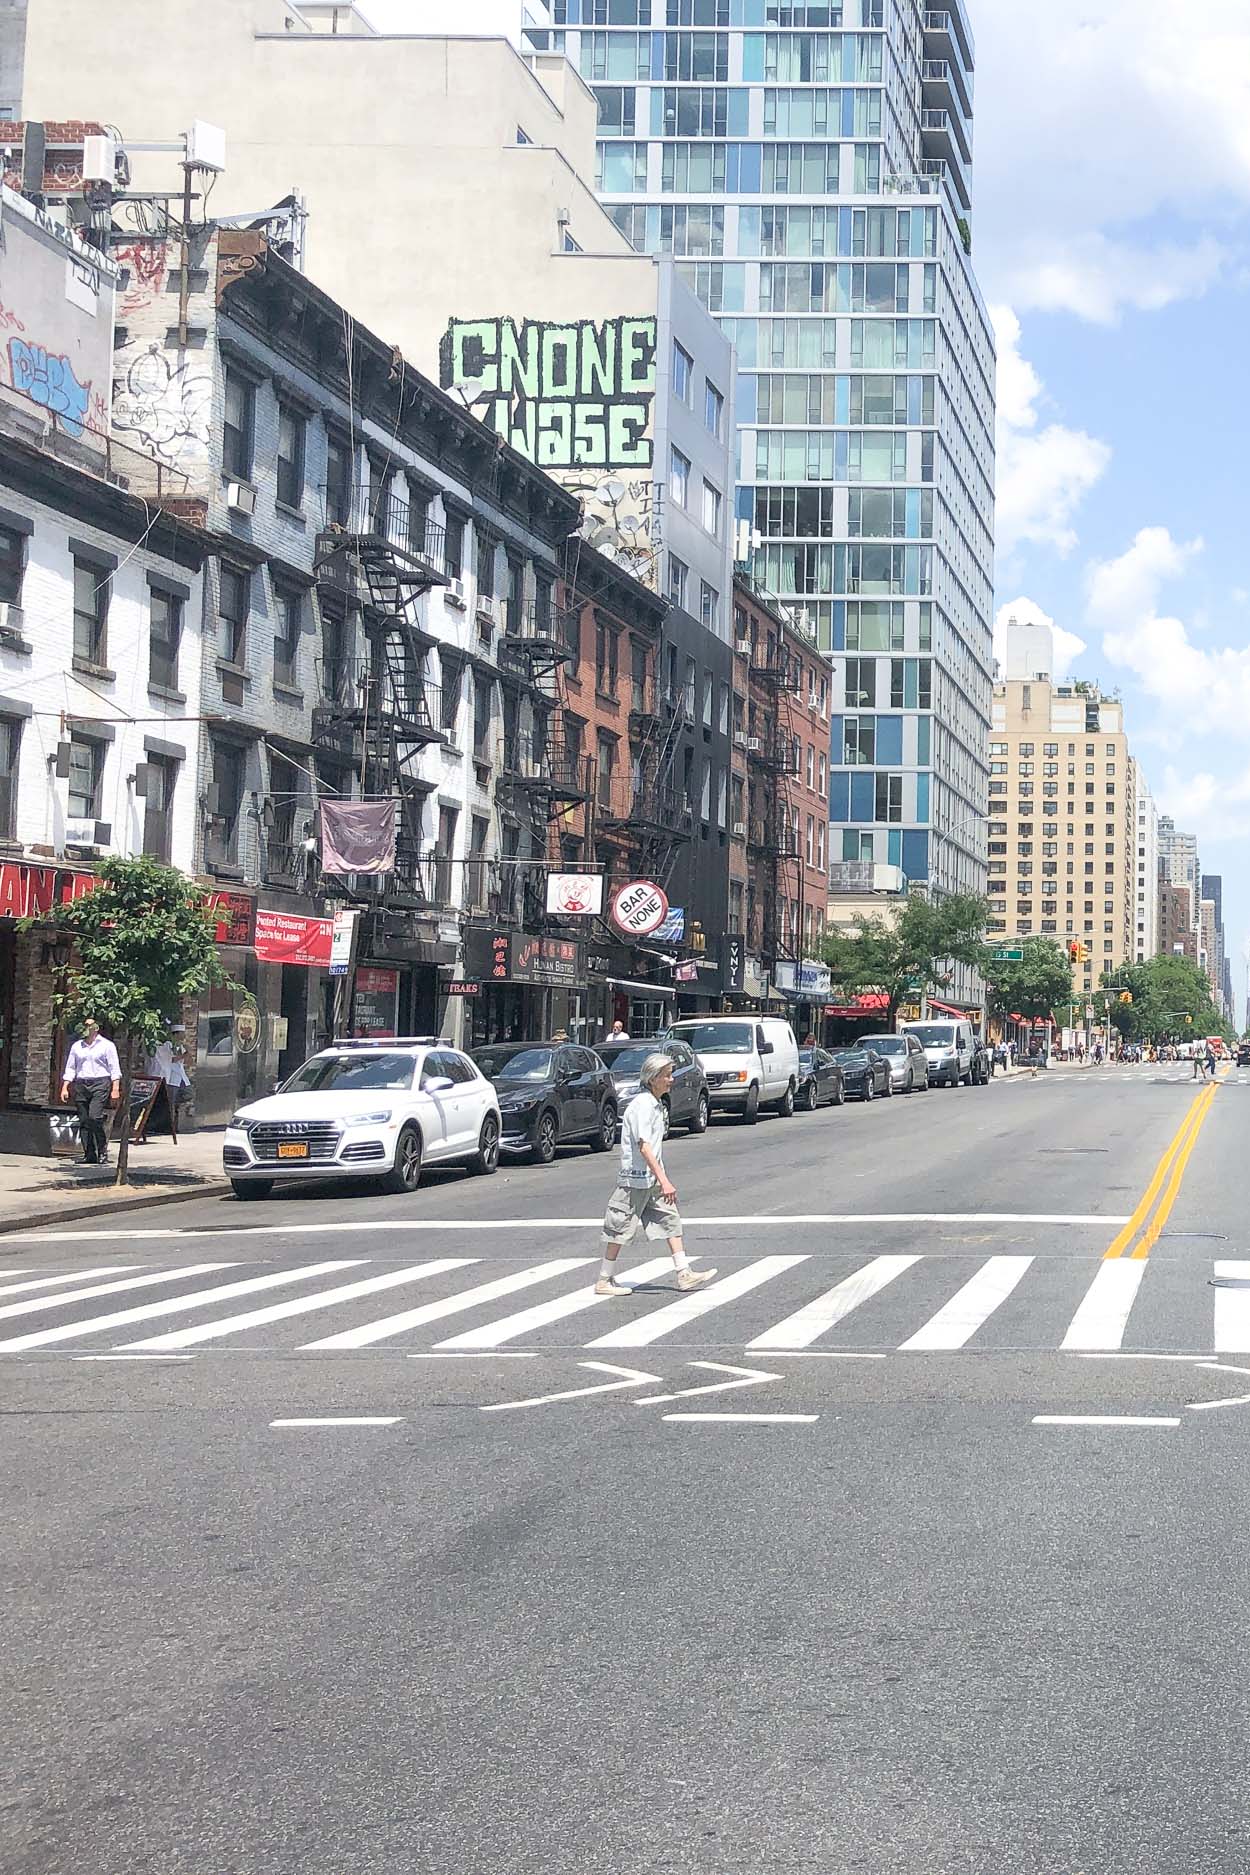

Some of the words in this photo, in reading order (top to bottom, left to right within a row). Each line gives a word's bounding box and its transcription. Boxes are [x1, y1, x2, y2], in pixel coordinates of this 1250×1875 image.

[620, 887, 648, 914] BAR
[629, 898, 661, 928] NONE
[730, 947, 740, 987] VNYL
